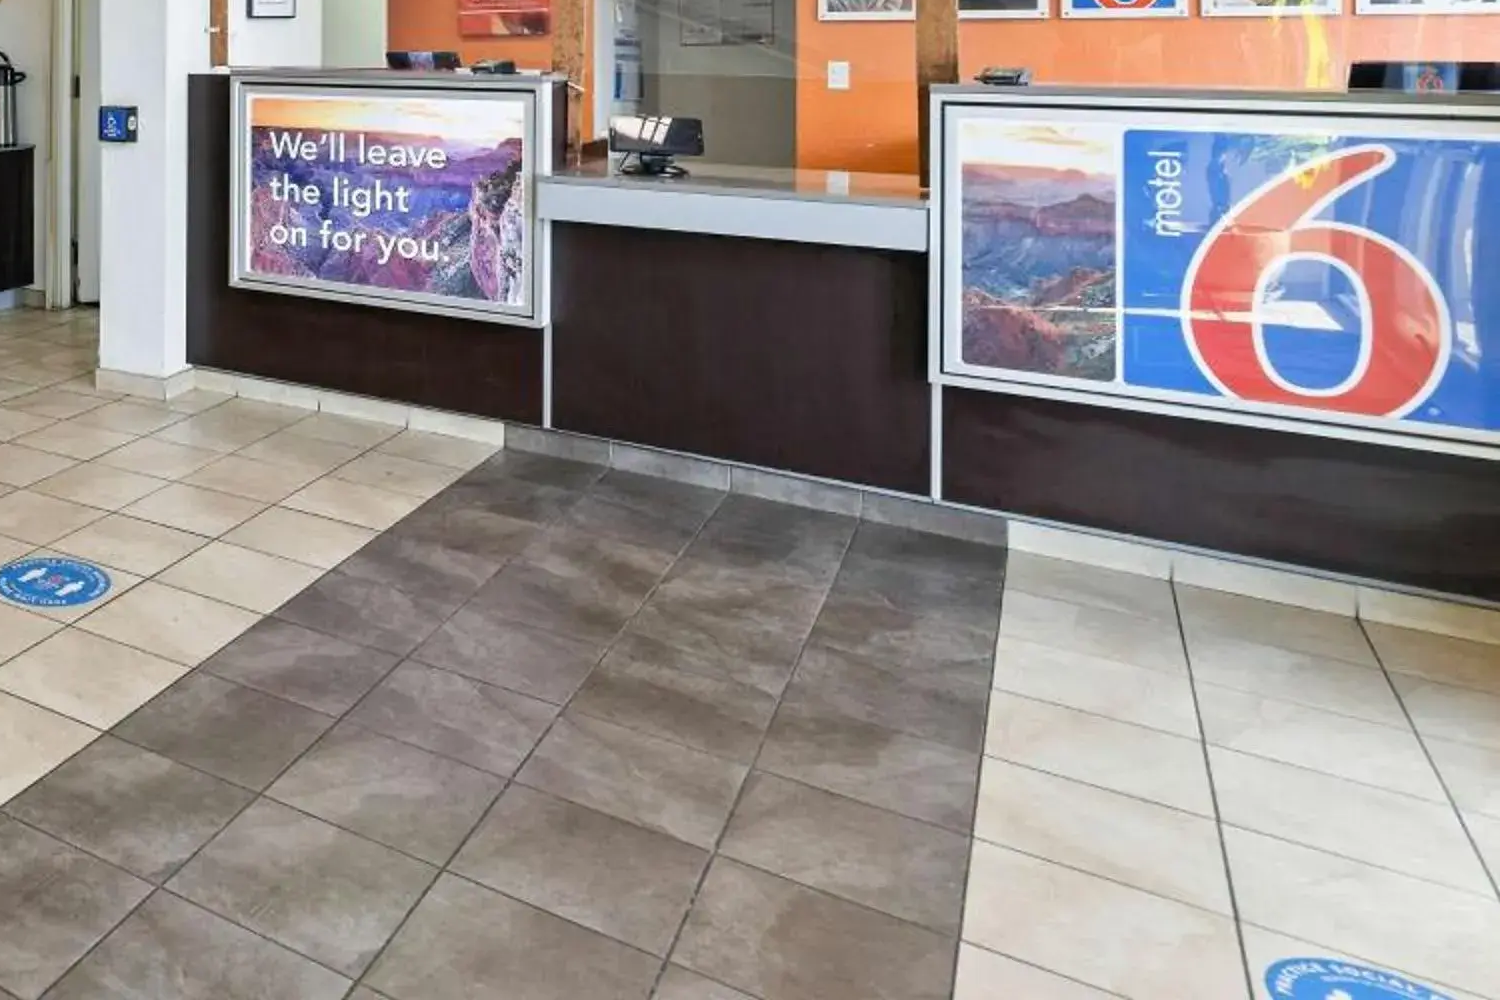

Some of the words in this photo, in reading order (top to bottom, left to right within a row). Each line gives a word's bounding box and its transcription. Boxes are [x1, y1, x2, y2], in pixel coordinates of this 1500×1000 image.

[269, 131, 346, 163] We'll
[359, 133, 447, 169] leave
[269, 173, 321, 206] the
[333, 176, 411, 217] light
[1147, 151, 1183, 239] motel
[269, 223, 308, 247] on
[319, 219, 368, 253] for
[375, 233, 451, 265] you.
[1180, 143, 1451, 420] 6
